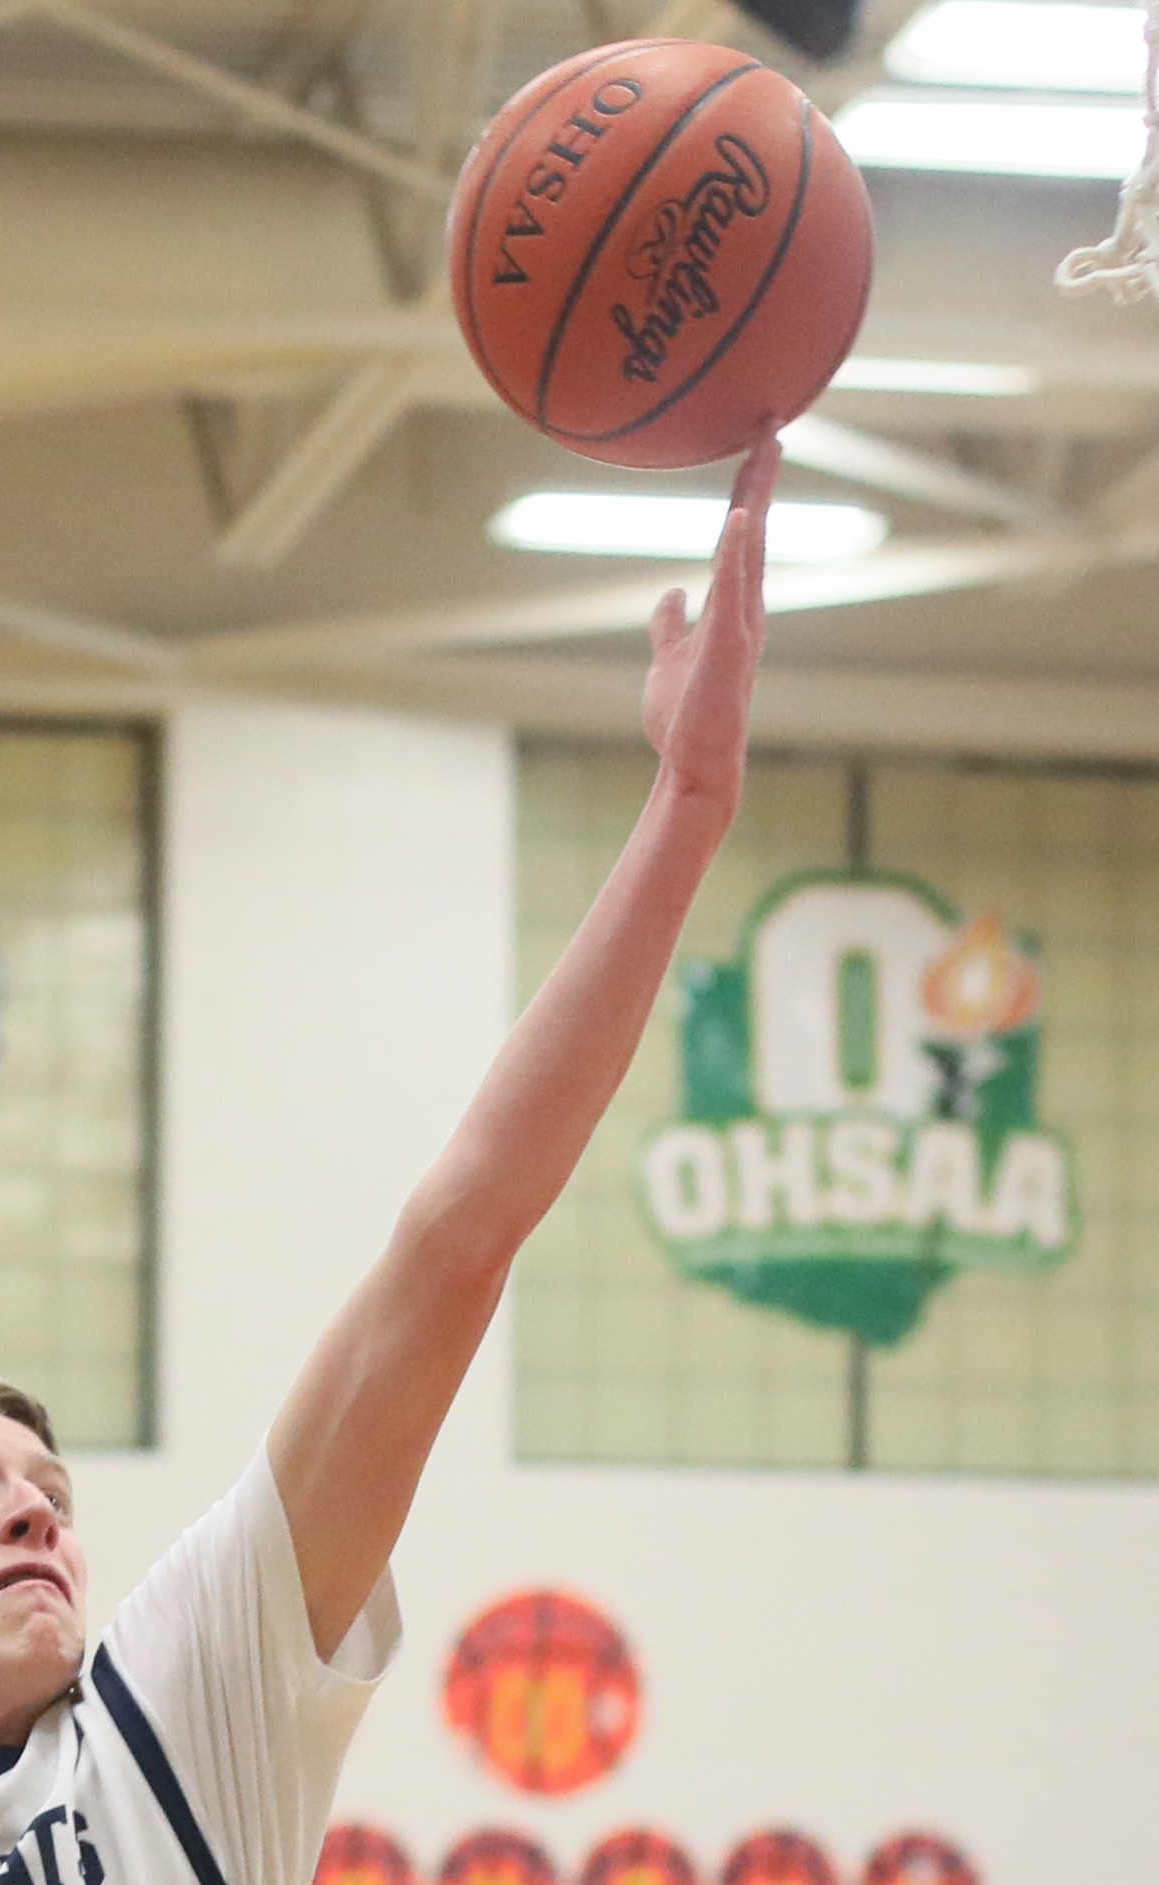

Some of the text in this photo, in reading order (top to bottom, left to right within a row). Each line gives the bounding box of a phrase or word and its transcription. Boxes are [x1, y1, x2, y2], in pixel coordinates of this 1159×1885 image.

[493, 79, 643, 285] OHSAA
[611, 133, 771, 384] Rawlings
[644, 1120, 1069, 1250] OHSAA
